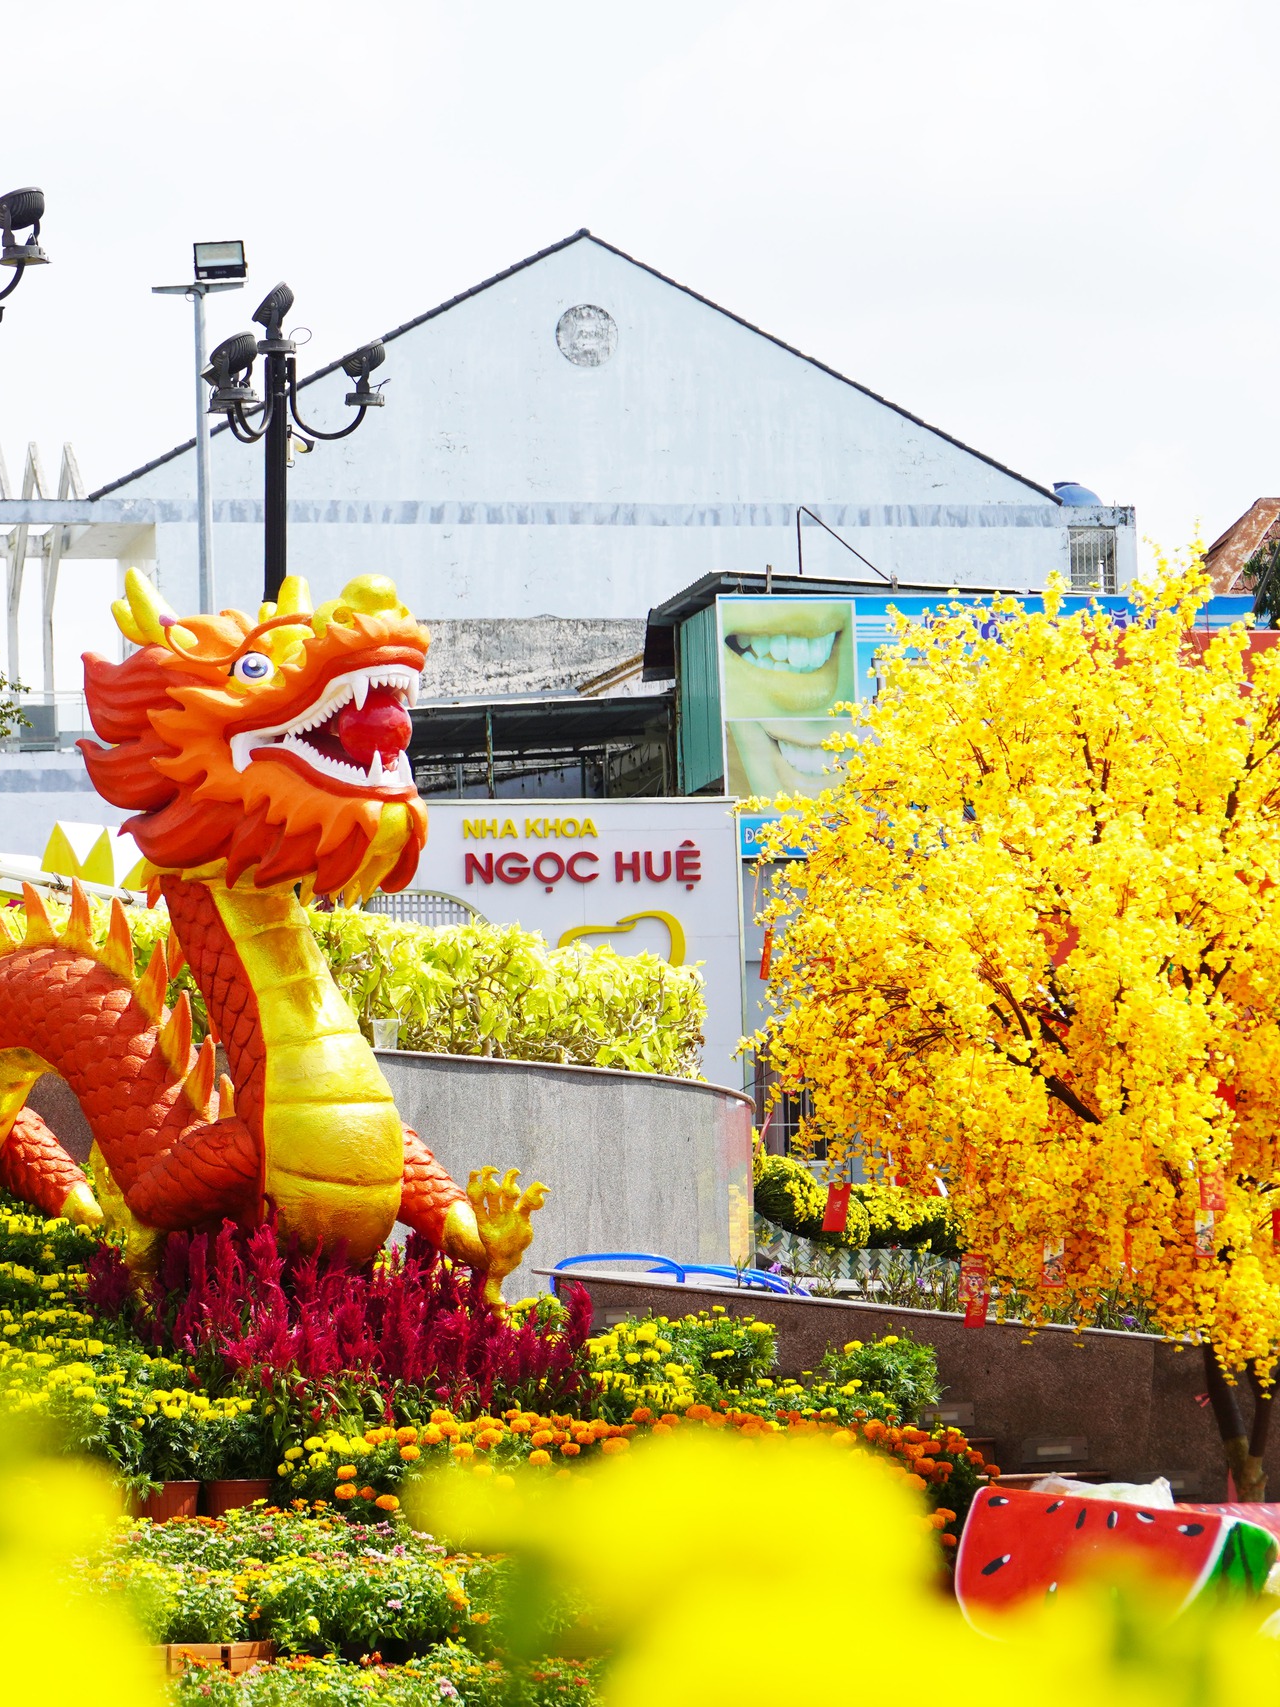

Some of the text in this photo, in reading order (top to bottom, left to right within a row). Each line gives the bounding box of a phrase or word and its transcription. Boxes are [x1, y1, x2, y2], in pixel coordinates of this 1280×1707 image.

[462, 817, 598, 839] NHA KHOA
[465, 839, 702, 893] NGỌC HUỆ
